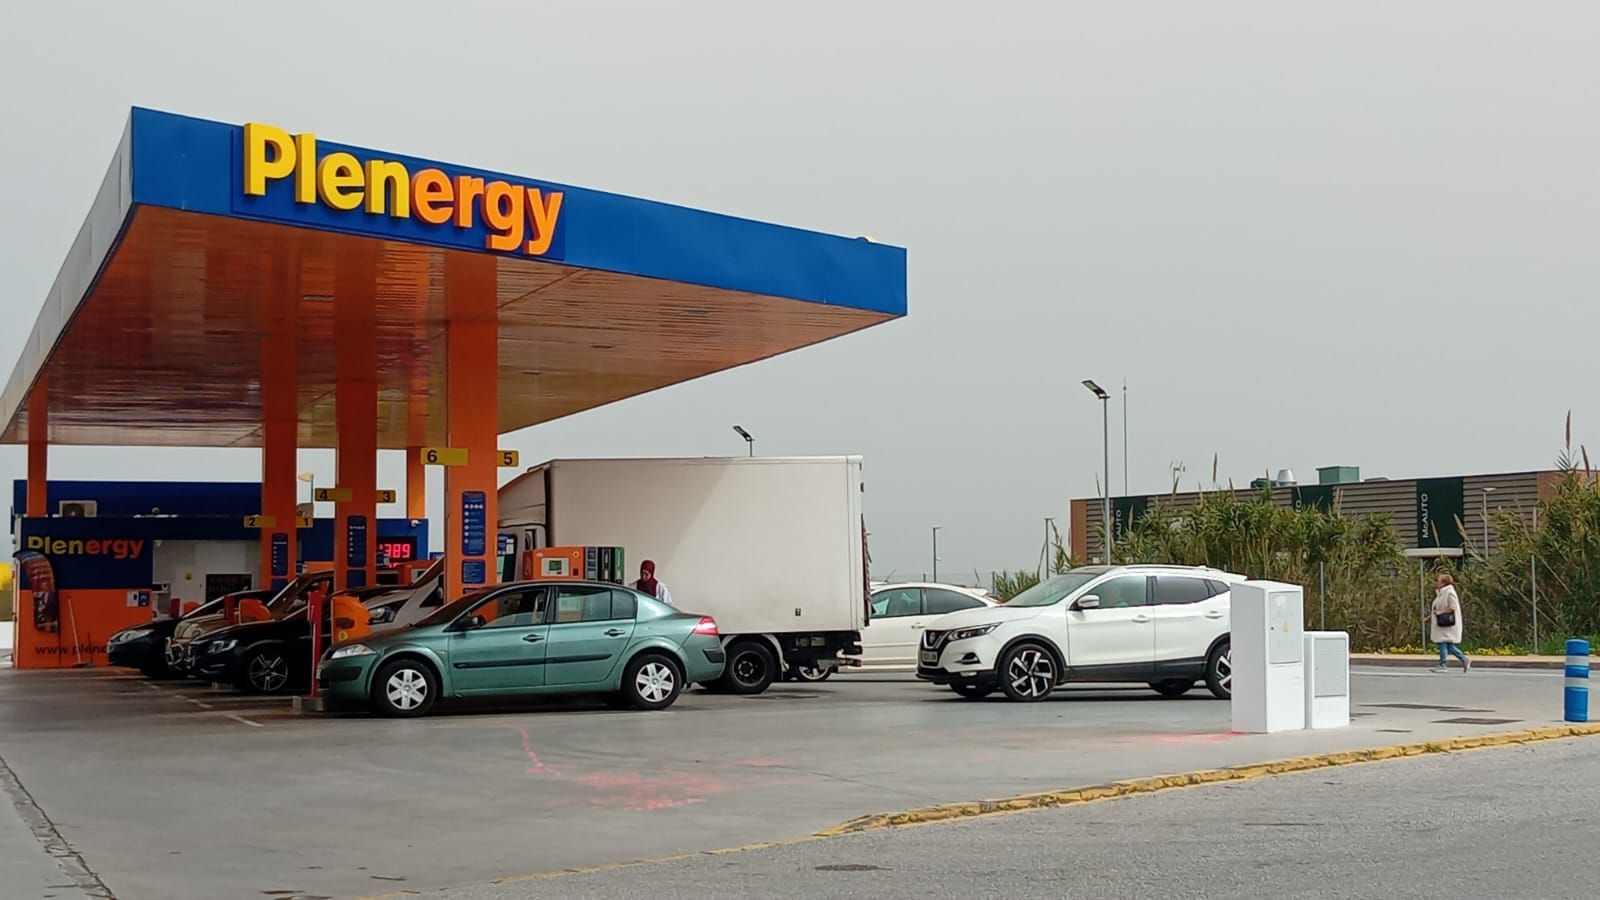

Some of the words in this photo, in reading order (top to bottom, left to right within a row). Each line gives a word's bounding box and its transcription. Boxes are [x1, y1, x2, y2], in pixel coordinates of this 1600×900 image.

[243, 122, 564, 256] Plenergy
[427, 450, 438, 463] 6
[503, 452, 513, 465] 5
[319, 490, 328, 500] 4
[383, 491, 391, 501] 3
[249, 518, 256, 526] 2
[303, 518, 309, 526] 1
[27, 536, 145, 559] Plenergy
